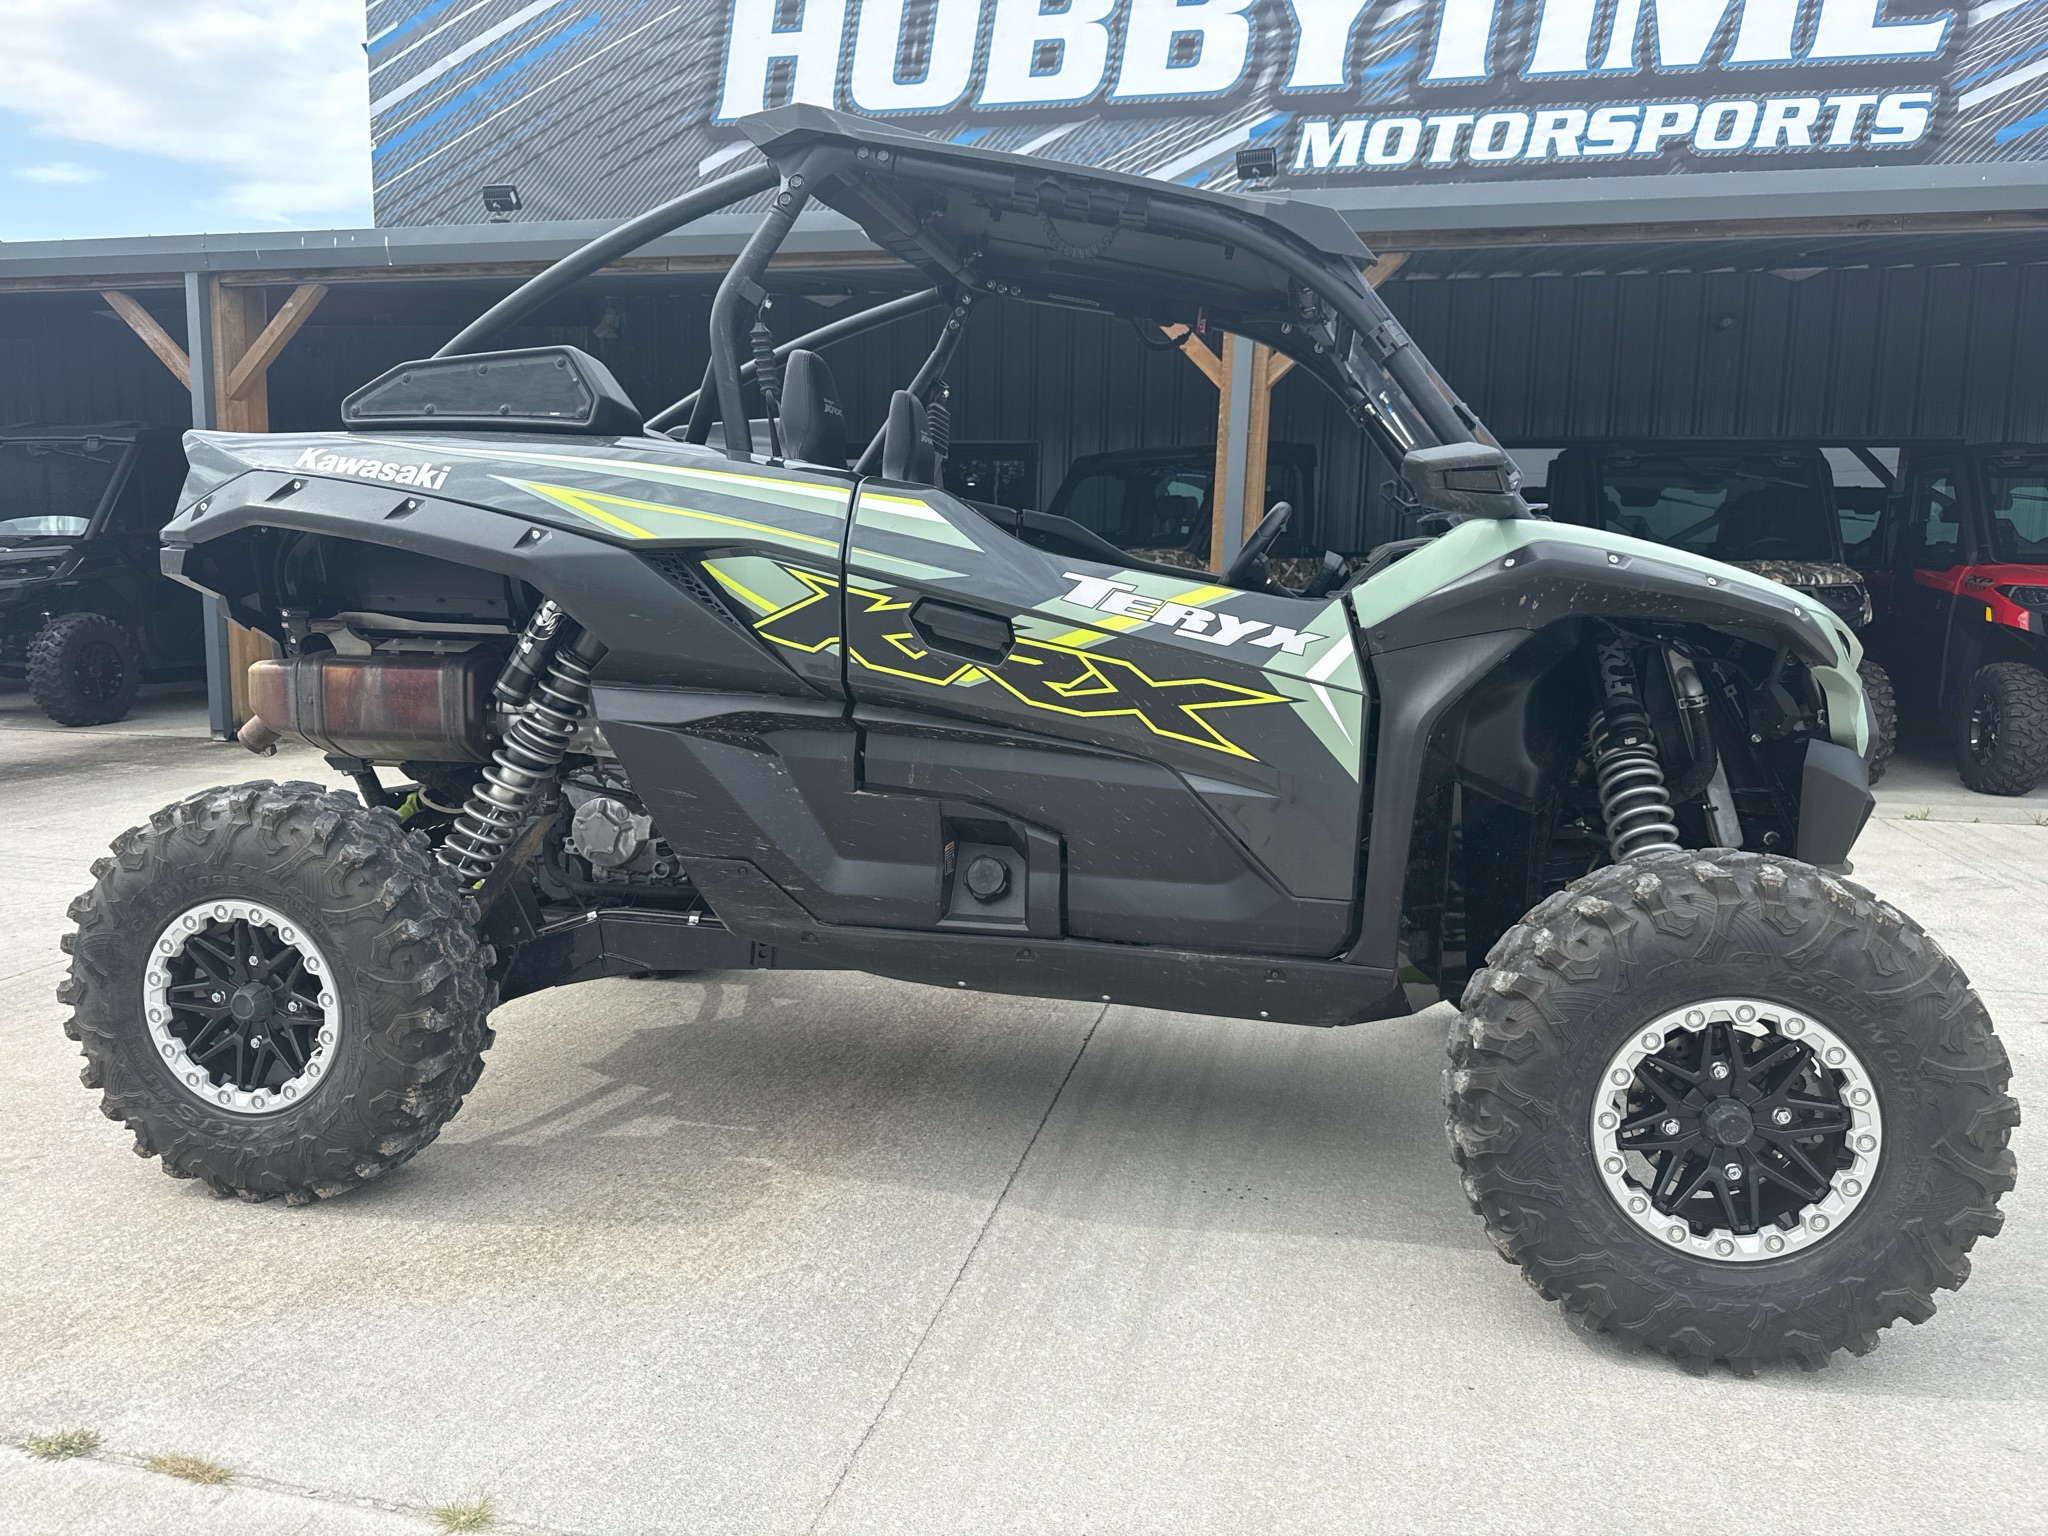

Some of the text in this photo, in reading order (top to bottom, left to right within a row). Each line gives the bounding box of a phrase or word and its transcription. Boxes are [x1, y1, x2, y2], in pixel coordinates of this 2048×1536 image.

[1292, 91, 1934, 170] MOTORSPORTS
[293, 447, 452, 490] Kawasaki
[1061, 571, 1330, 656] TERYX
[1597, 640, 1635, 699] FOX
